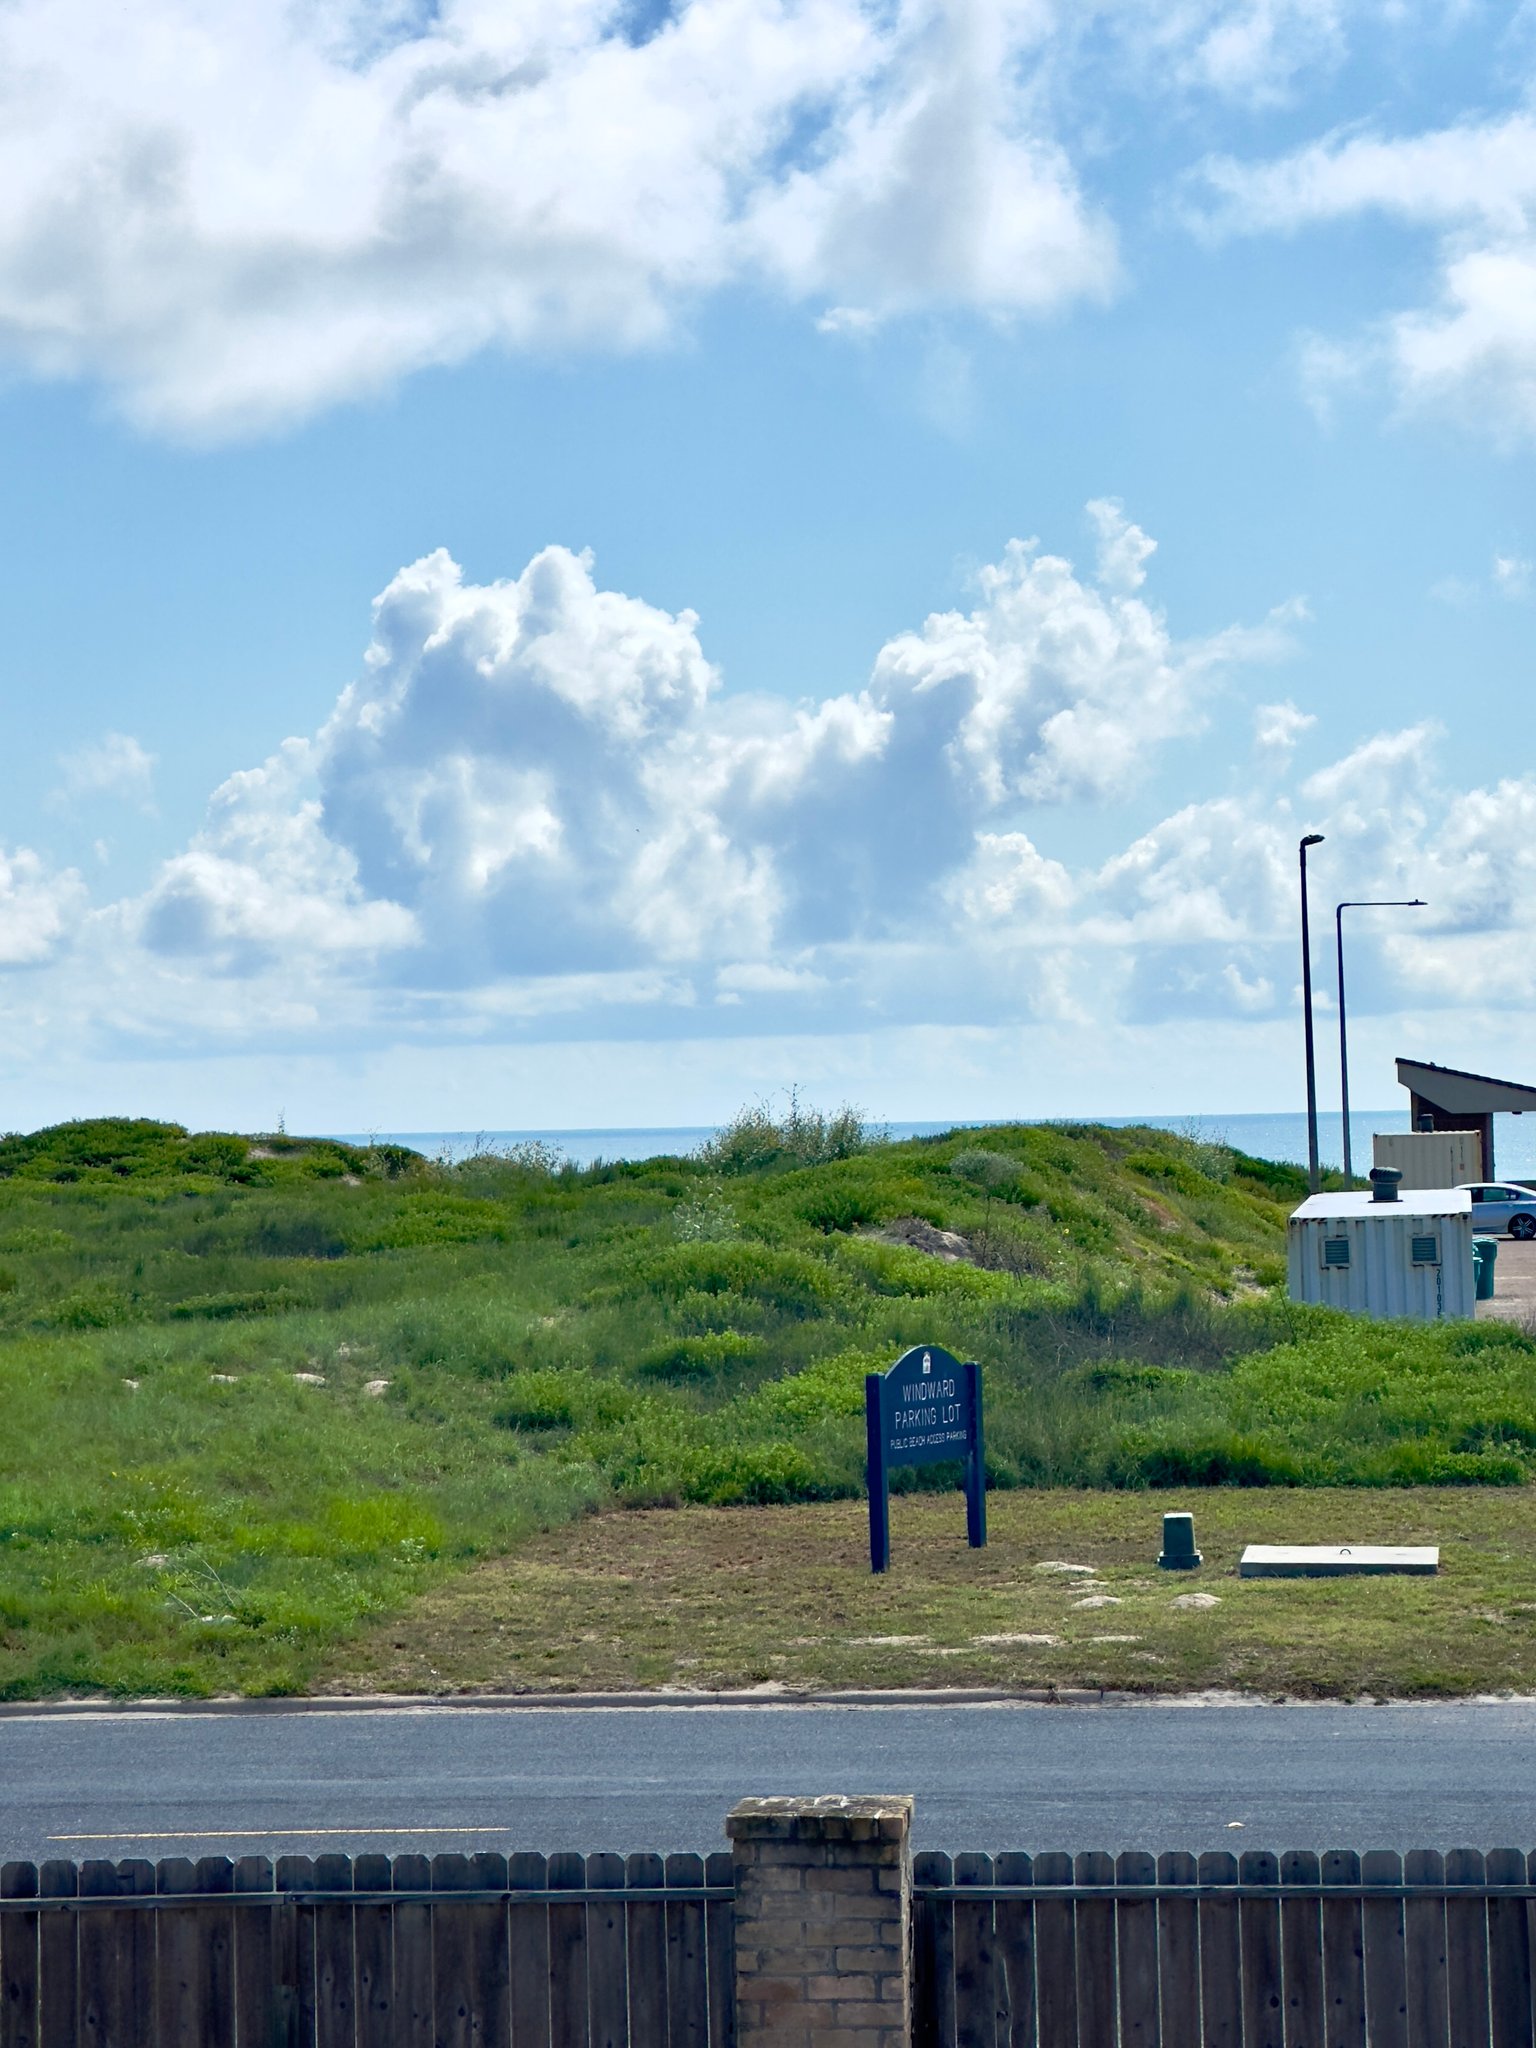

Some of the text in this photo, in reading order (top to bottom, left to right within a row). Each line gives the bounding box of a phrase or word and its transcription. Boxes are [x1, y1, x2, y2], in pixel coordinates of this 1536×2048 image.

[903, 1379, 955, 1402] WINDWARD
[895, 1403, 961, 1430] PARKING LOT
[890, 1430, 967, 1449] PUBLIC BEACH ACCESS PARKING
